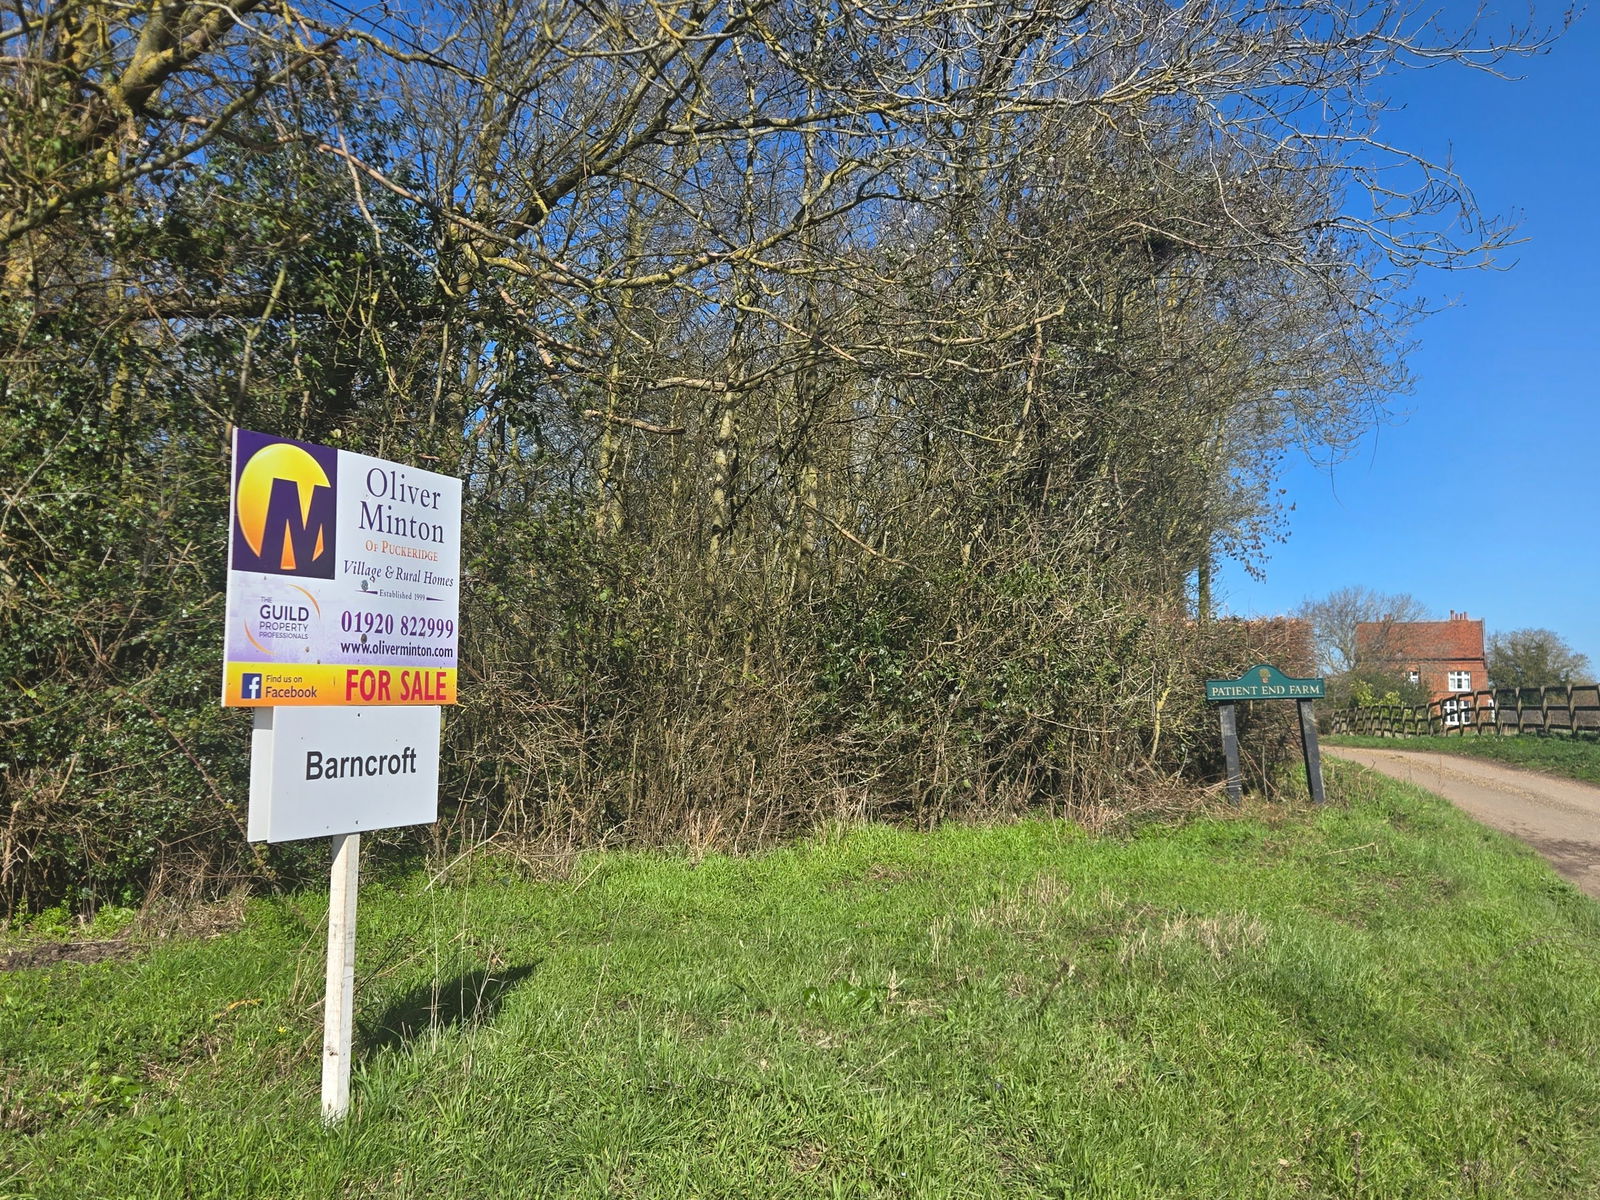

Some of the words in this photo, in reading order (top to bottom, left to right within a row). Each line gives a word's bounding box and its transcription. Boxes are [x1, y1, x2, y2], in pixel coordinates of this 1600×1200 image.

[366, 467, 441, 510] Oliver
[358, 500, 445, 544] Minton
[381, 540, 438, 562] PUCKERIDGE
[343, 559, 382, 583] Village
[385, 565, 395, 579] &
[396, 567, 421, 584] Rural
[423, 571, 454, 588] Homes
[260, 596, 273, 604] THE
[378, 588, 413, 601] Established
[259, 604, 310, 622] GUILD
[259, 621, 309, 632] PROPERTY
[340, 610, 394, 635] 01920
[400, 615, 454, 639] 822999
[258, 631, 309, 640] PROFESSIONALS
[340, 640, 454, 658] www.oliverminton.com
[265, 674, 282, 684] Find
[293, 675, 303, 684] on
[345, 669, 391, 701] FOR
[400, 670, 447, 701] SALE
[265, 685, 317, 699] Facebook
[1211, 686, 1258, 697] PATIENT
[1261, 685, 1285, 695] END
[1289, 684, 1320, 695] FARM
[305, 746, 417, 781] Barncroft
